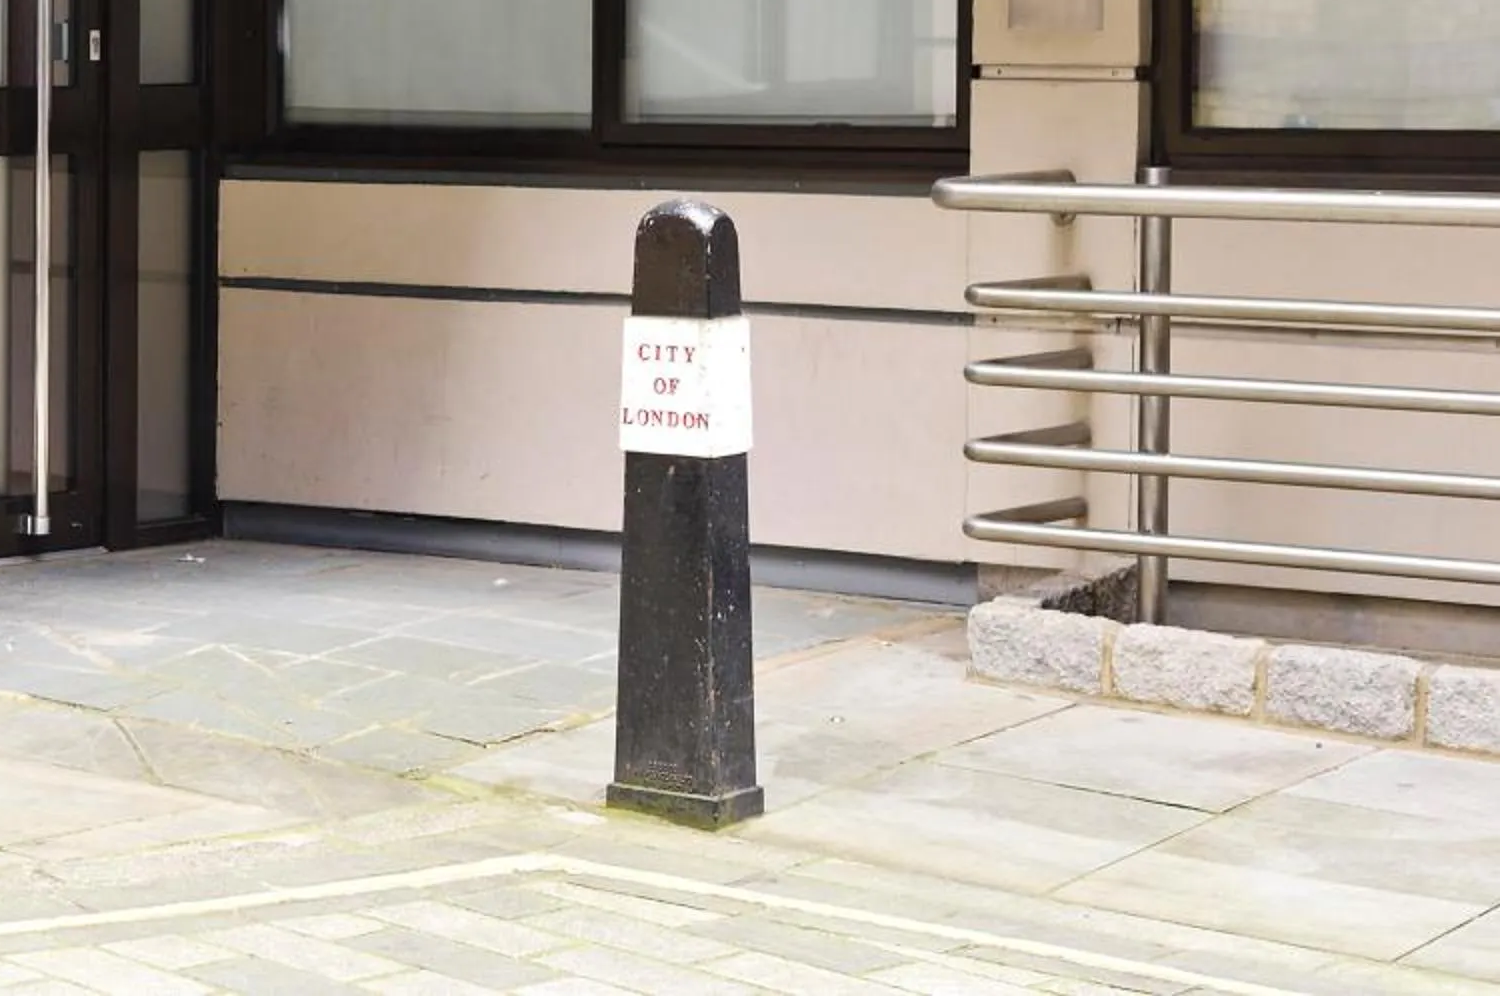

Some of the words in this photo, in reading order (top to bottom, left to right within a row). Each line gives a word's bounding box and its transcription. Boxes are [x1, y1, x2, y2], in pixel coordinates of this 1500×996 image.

[637, 343, 696, 364] CITY
[653, 376, 681, 396] OF
[621, 406, 711, 432] LONDON
